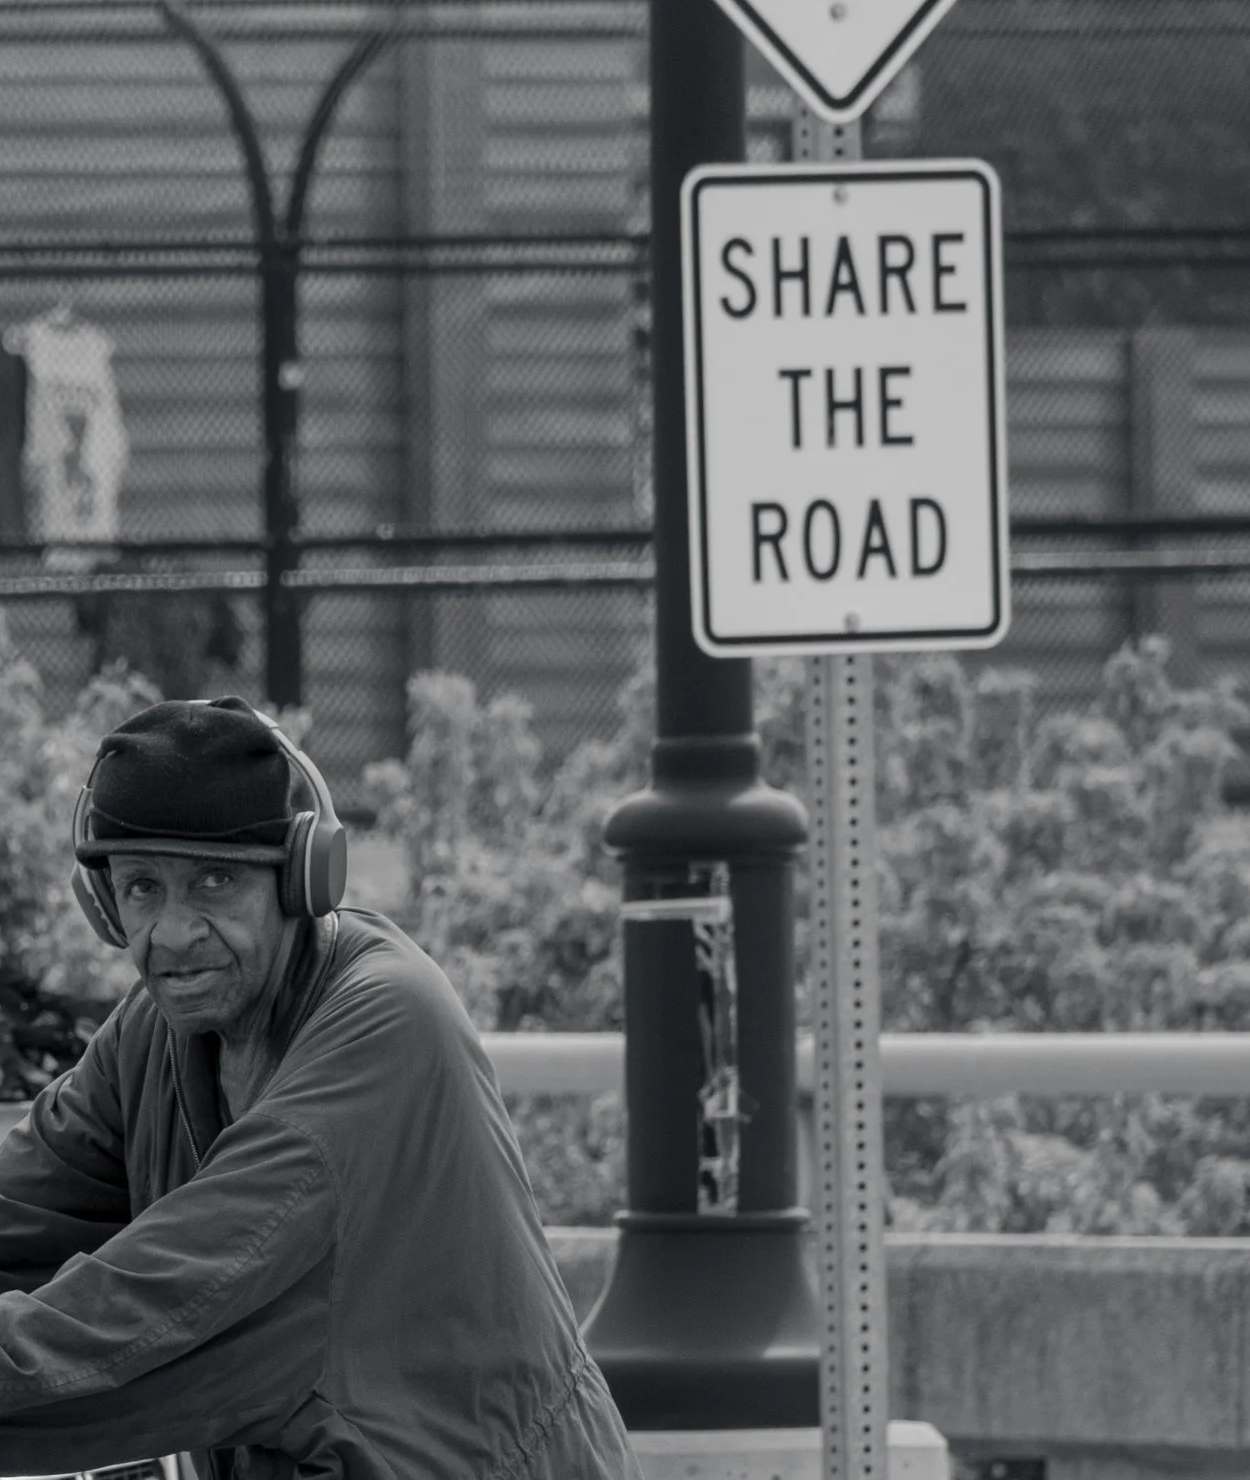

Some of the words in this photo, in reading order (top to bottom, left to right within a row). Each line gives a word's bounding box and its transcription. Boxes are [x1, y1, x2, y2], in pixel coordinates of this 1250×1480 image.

[720, 232, 967, 319] SHARE
[779, 366, 914, 449] THE
[751, 497, 947, 582] ROAD
